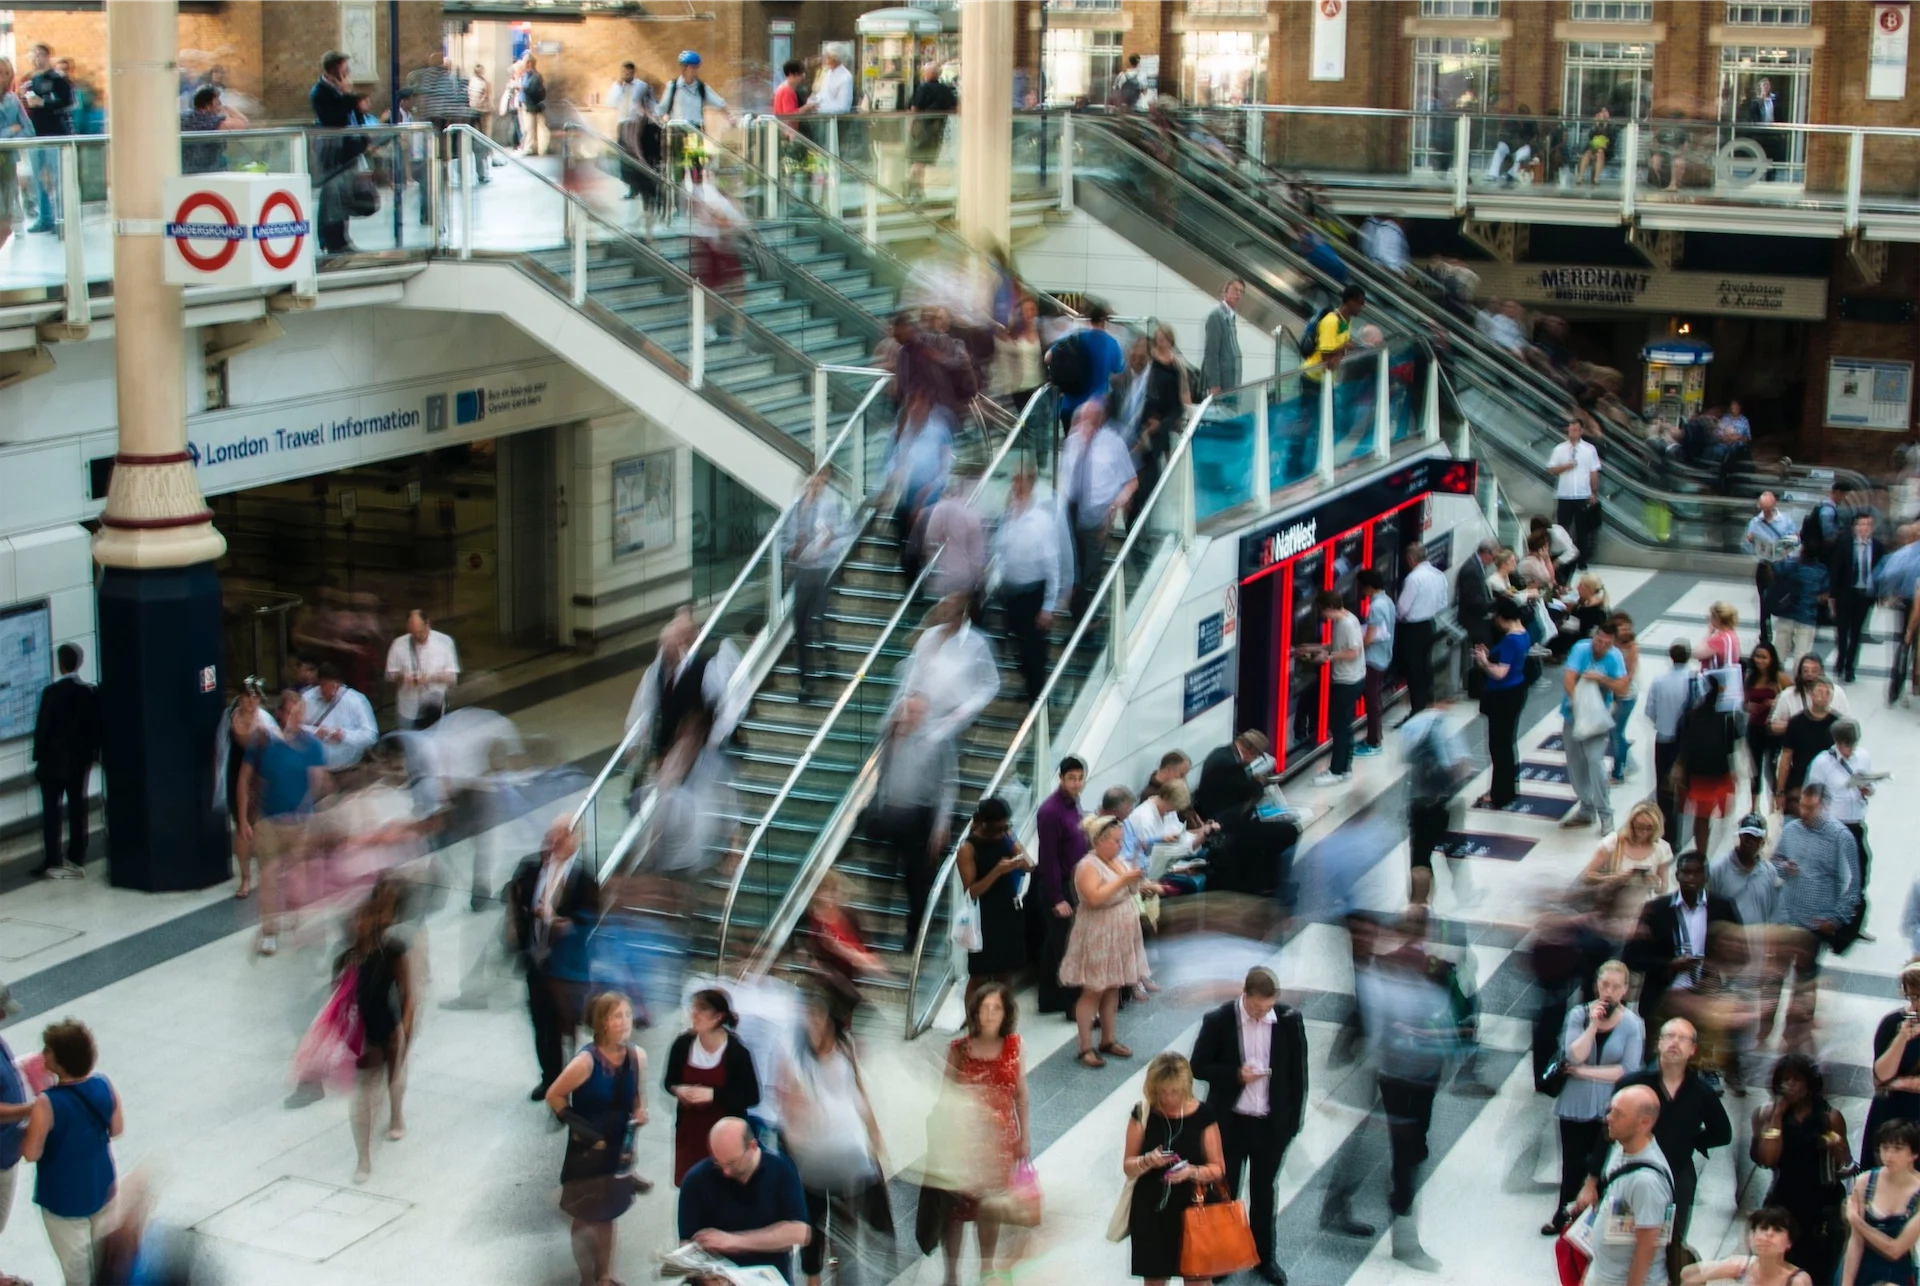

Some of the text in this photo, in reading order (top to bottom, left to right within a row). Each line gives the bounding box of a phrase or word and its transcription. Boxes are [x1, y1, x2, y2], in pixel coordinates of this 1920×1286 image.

[1325, 0, 1338, 14] A
[1885, 12, 1898, 28] B
[171, 224, 244, 237] UNDERGROUND
[255, 221, 307, 237] UNDERGROUND
[1541, 267, 1651, 292] MERCHANT
[206, 408, 420, 466] London Travel Information
[1275, 516, 1317, 562] NatWest
